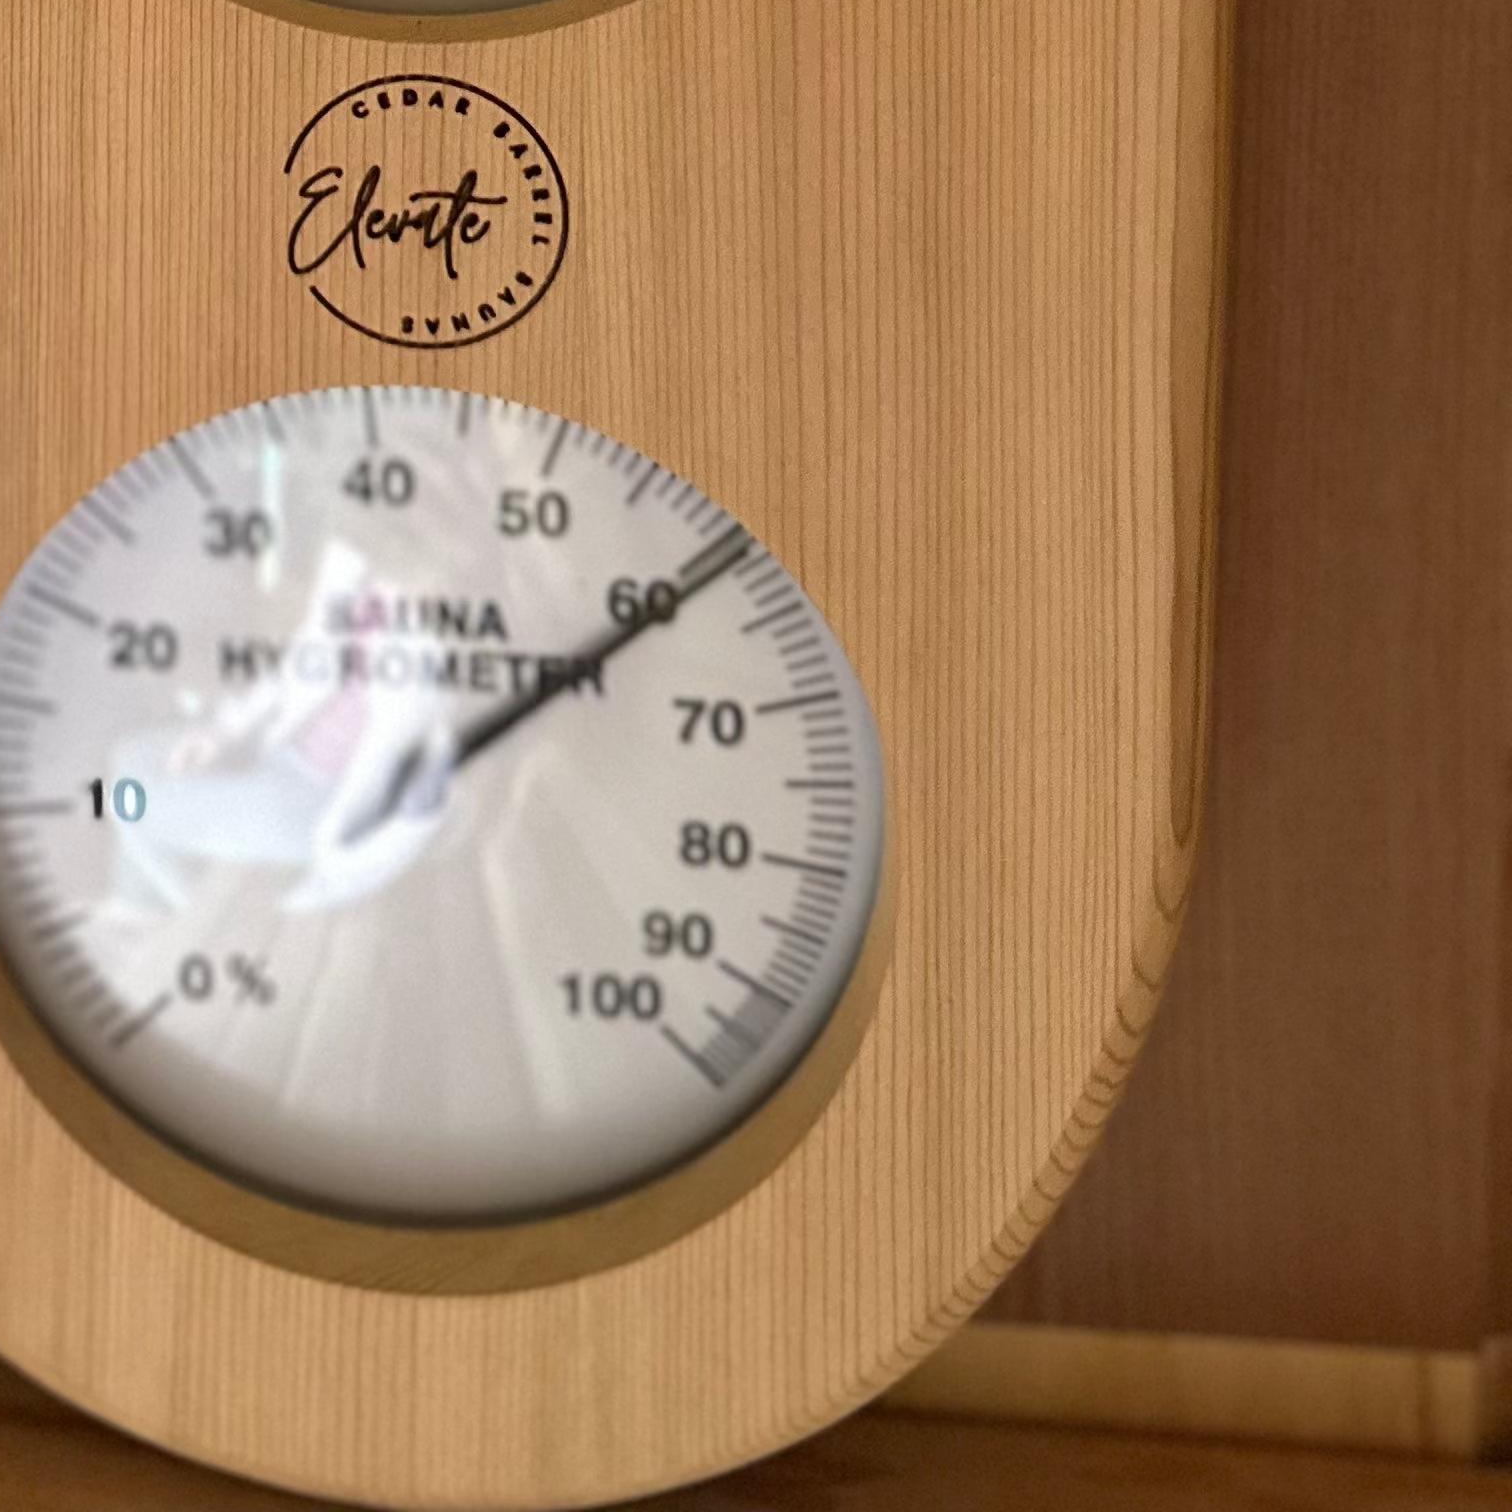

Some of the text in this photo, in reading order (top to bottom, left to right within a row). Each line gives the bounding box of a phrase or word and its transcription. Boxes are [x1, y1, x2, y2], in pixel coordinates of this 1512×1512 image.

[288, 165, 508, 280] Elevate
[342, 460, 416, 507] 40
[205, 511, 272, 560] 30
[498, 492, 571, 538] 50
[326, 600, 509, 641] SAUNA
[608, 580, 676, 626] 60
[109, 626, 178, 671] 20
[673, 699, 745, 747] 70
[88, 779, 147, 822] 10
[680, 822, 751, 868] 80
[644, 913, 712, 960] 90
[559, 974, 663, 1022] 100
